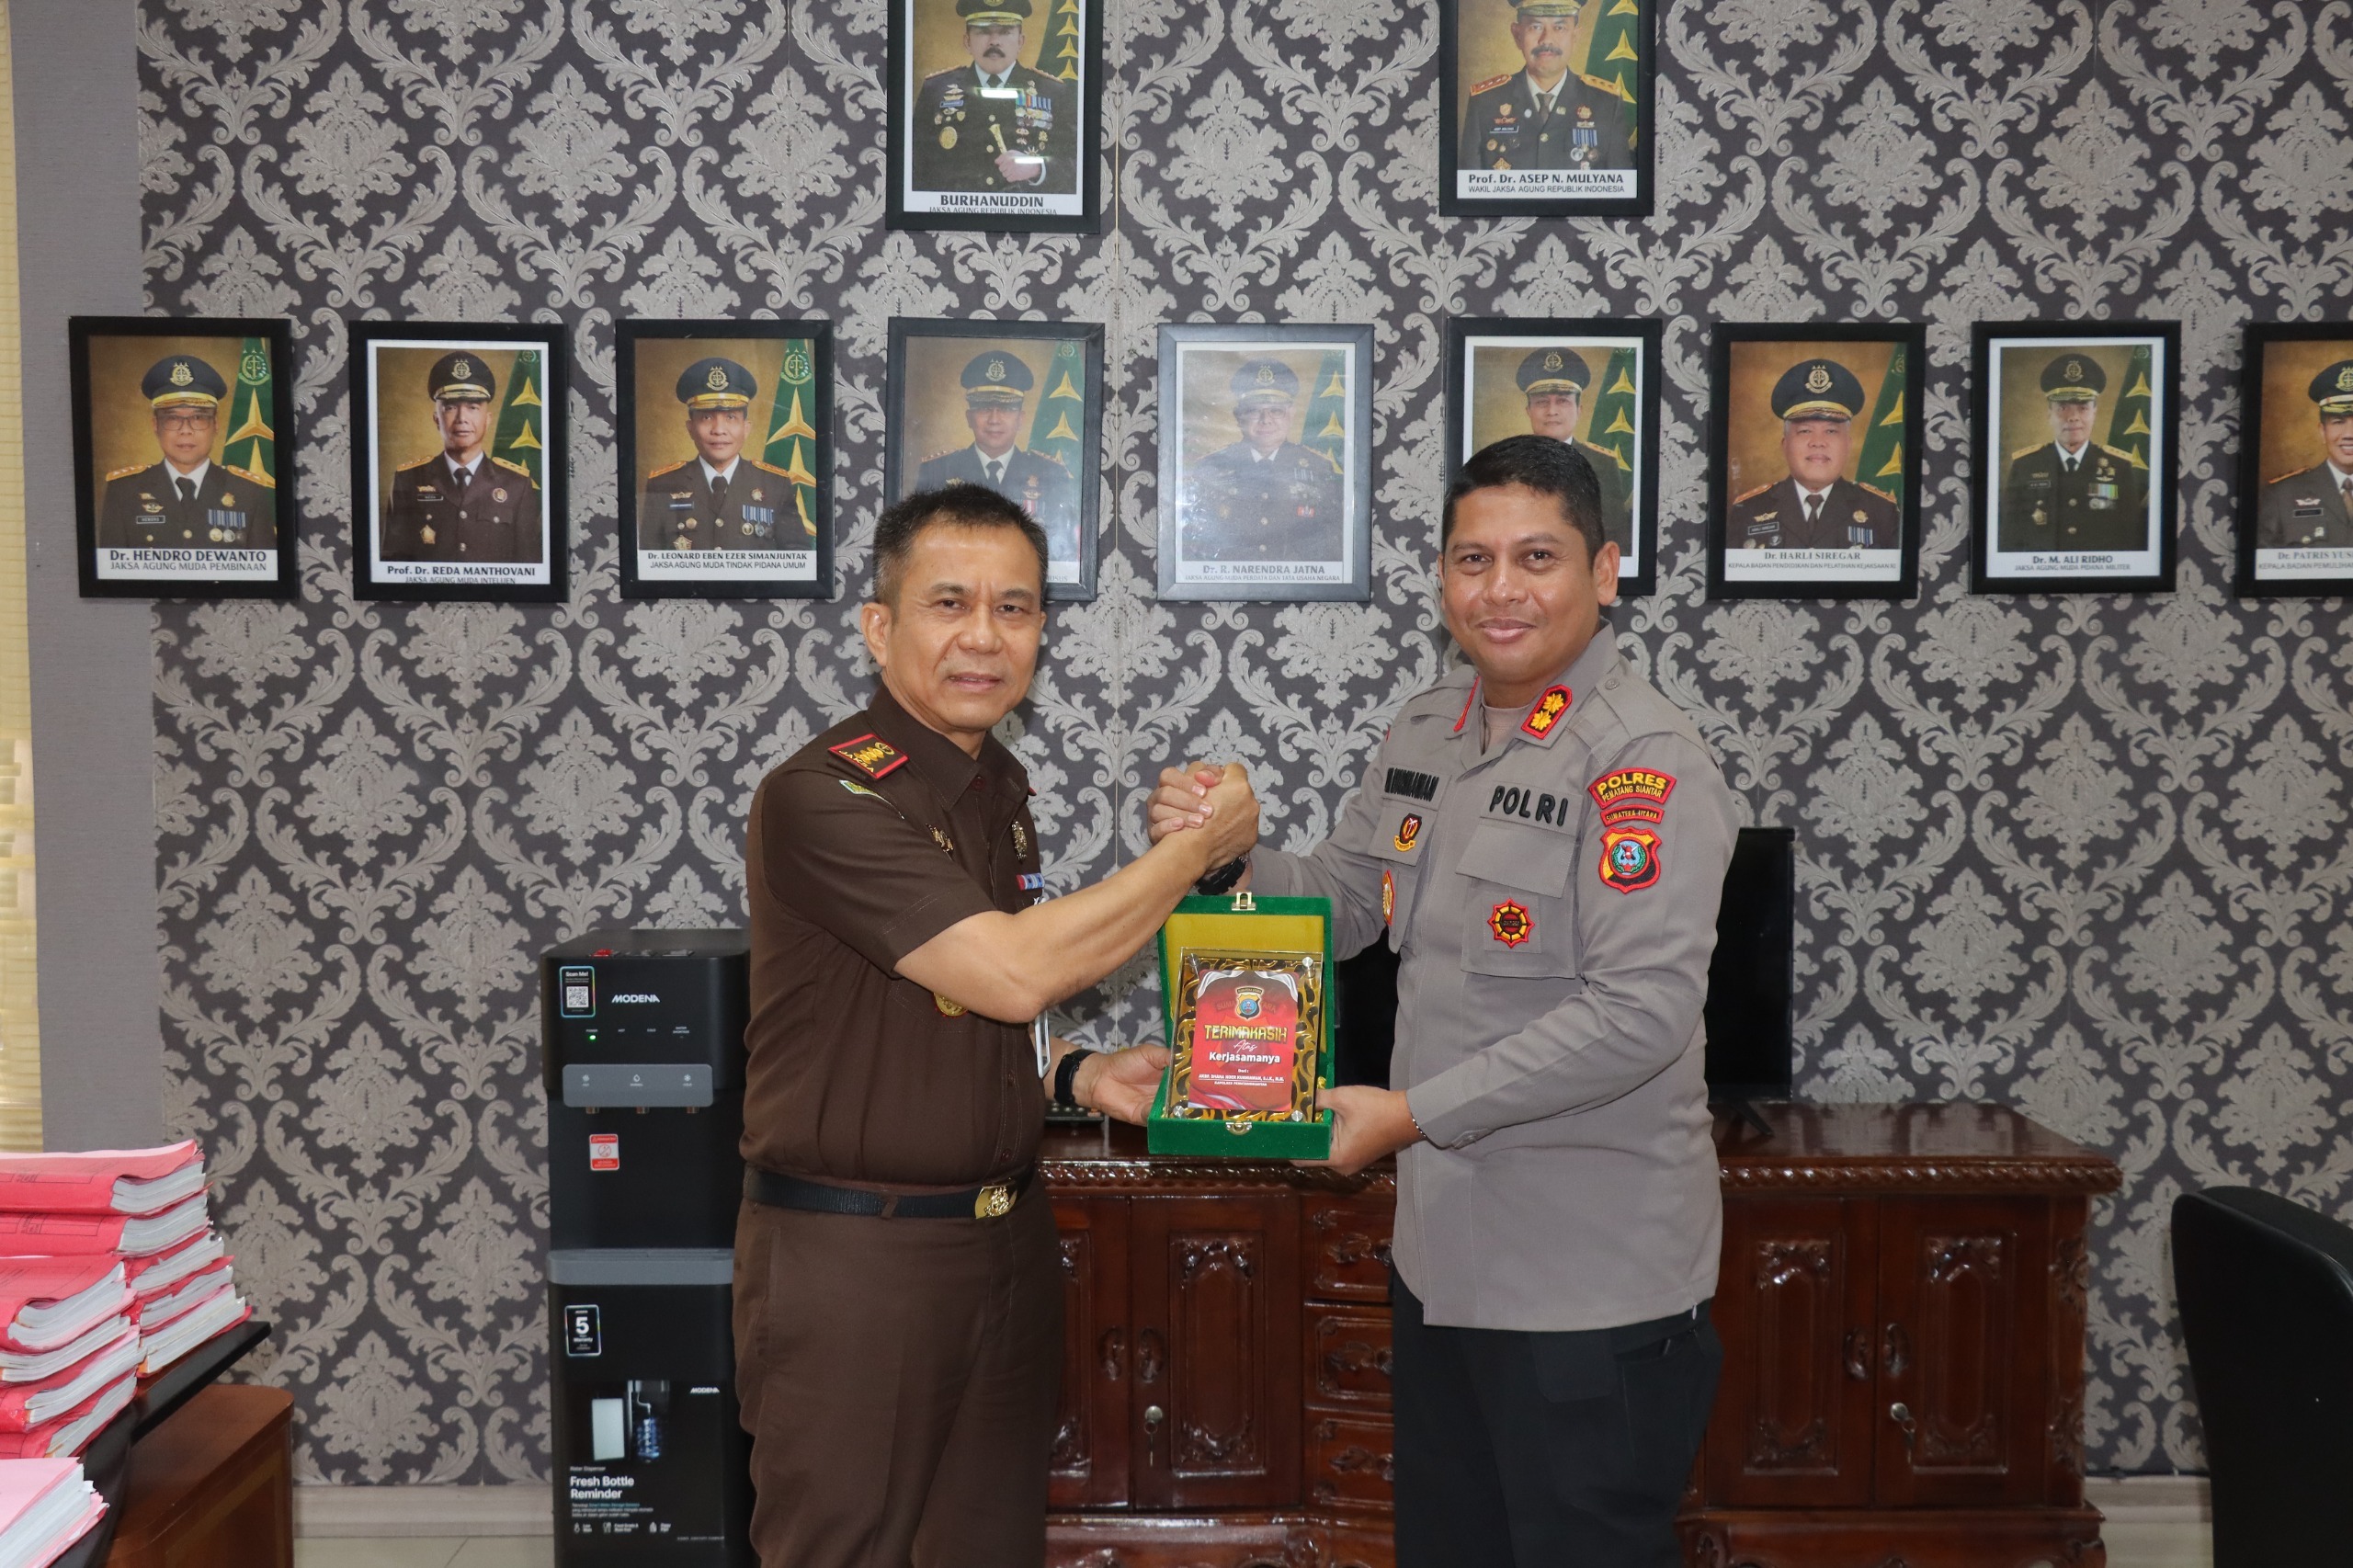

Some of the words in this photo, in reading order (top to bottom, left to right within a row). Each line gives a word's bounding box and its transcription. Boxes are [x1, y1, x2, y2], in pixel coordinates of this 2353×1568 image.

[1469, 175, 1495, 184] Prof.
[1499, 175, 1516, 184] Dr.
[1519, 175, 1548, 184] ASEP
[1552, 175, 1563, 184] N.
[1566, 175, 1623, 184] MULYANA
[940, 195, 1043, 207] BURHANUDDIN
[110, 550, 130, 561] Dr.
[133, 550, 191, 561] HENDRO
[196, 550, 267, 561] DEWANTO
[2032, 555, 2047, 563] Dr.
[2049, 555, 2061, 563] M.
[2063, 555, 2079, 563] ALI
[2081, 555, 2113, 563] RIDHO
[2293, 551, 2329, 560] PATRIS
[2332, 551, 2353, 560] YUS
[387, 566, 412, 574] Prof.
[415, 566, 430, 574] Dr.
[432, 567, 460, 575] REDA
[463, 567, 535, 575] MANTHOVANI
[1220, 565, 1230, 574] R.
[1233, 565, 1290, 574] NARENDRA
[1293, 565, 1325, 574] JATNA
[1597, 772, 1666, 795] POLRES
[1636, 785, 1662, 798] SIANTAR
[1489, 785, 1569, 827] POLRI
[611, 994, 660, 1003] MODENA
[1204, 1025, 1287, 1042] TERIMAKASIH
[1233, 1040, 1257, 1053] Atas
[1210, 1051, 1280, 1063] Kerjasamanya
[576, 1316, 589, 1334] 5
[570, 1476, 600, 1486] Fresh
[602, 1476, 634, 1486] Bottle
[571, 1488, 622, 1499] Reminder
